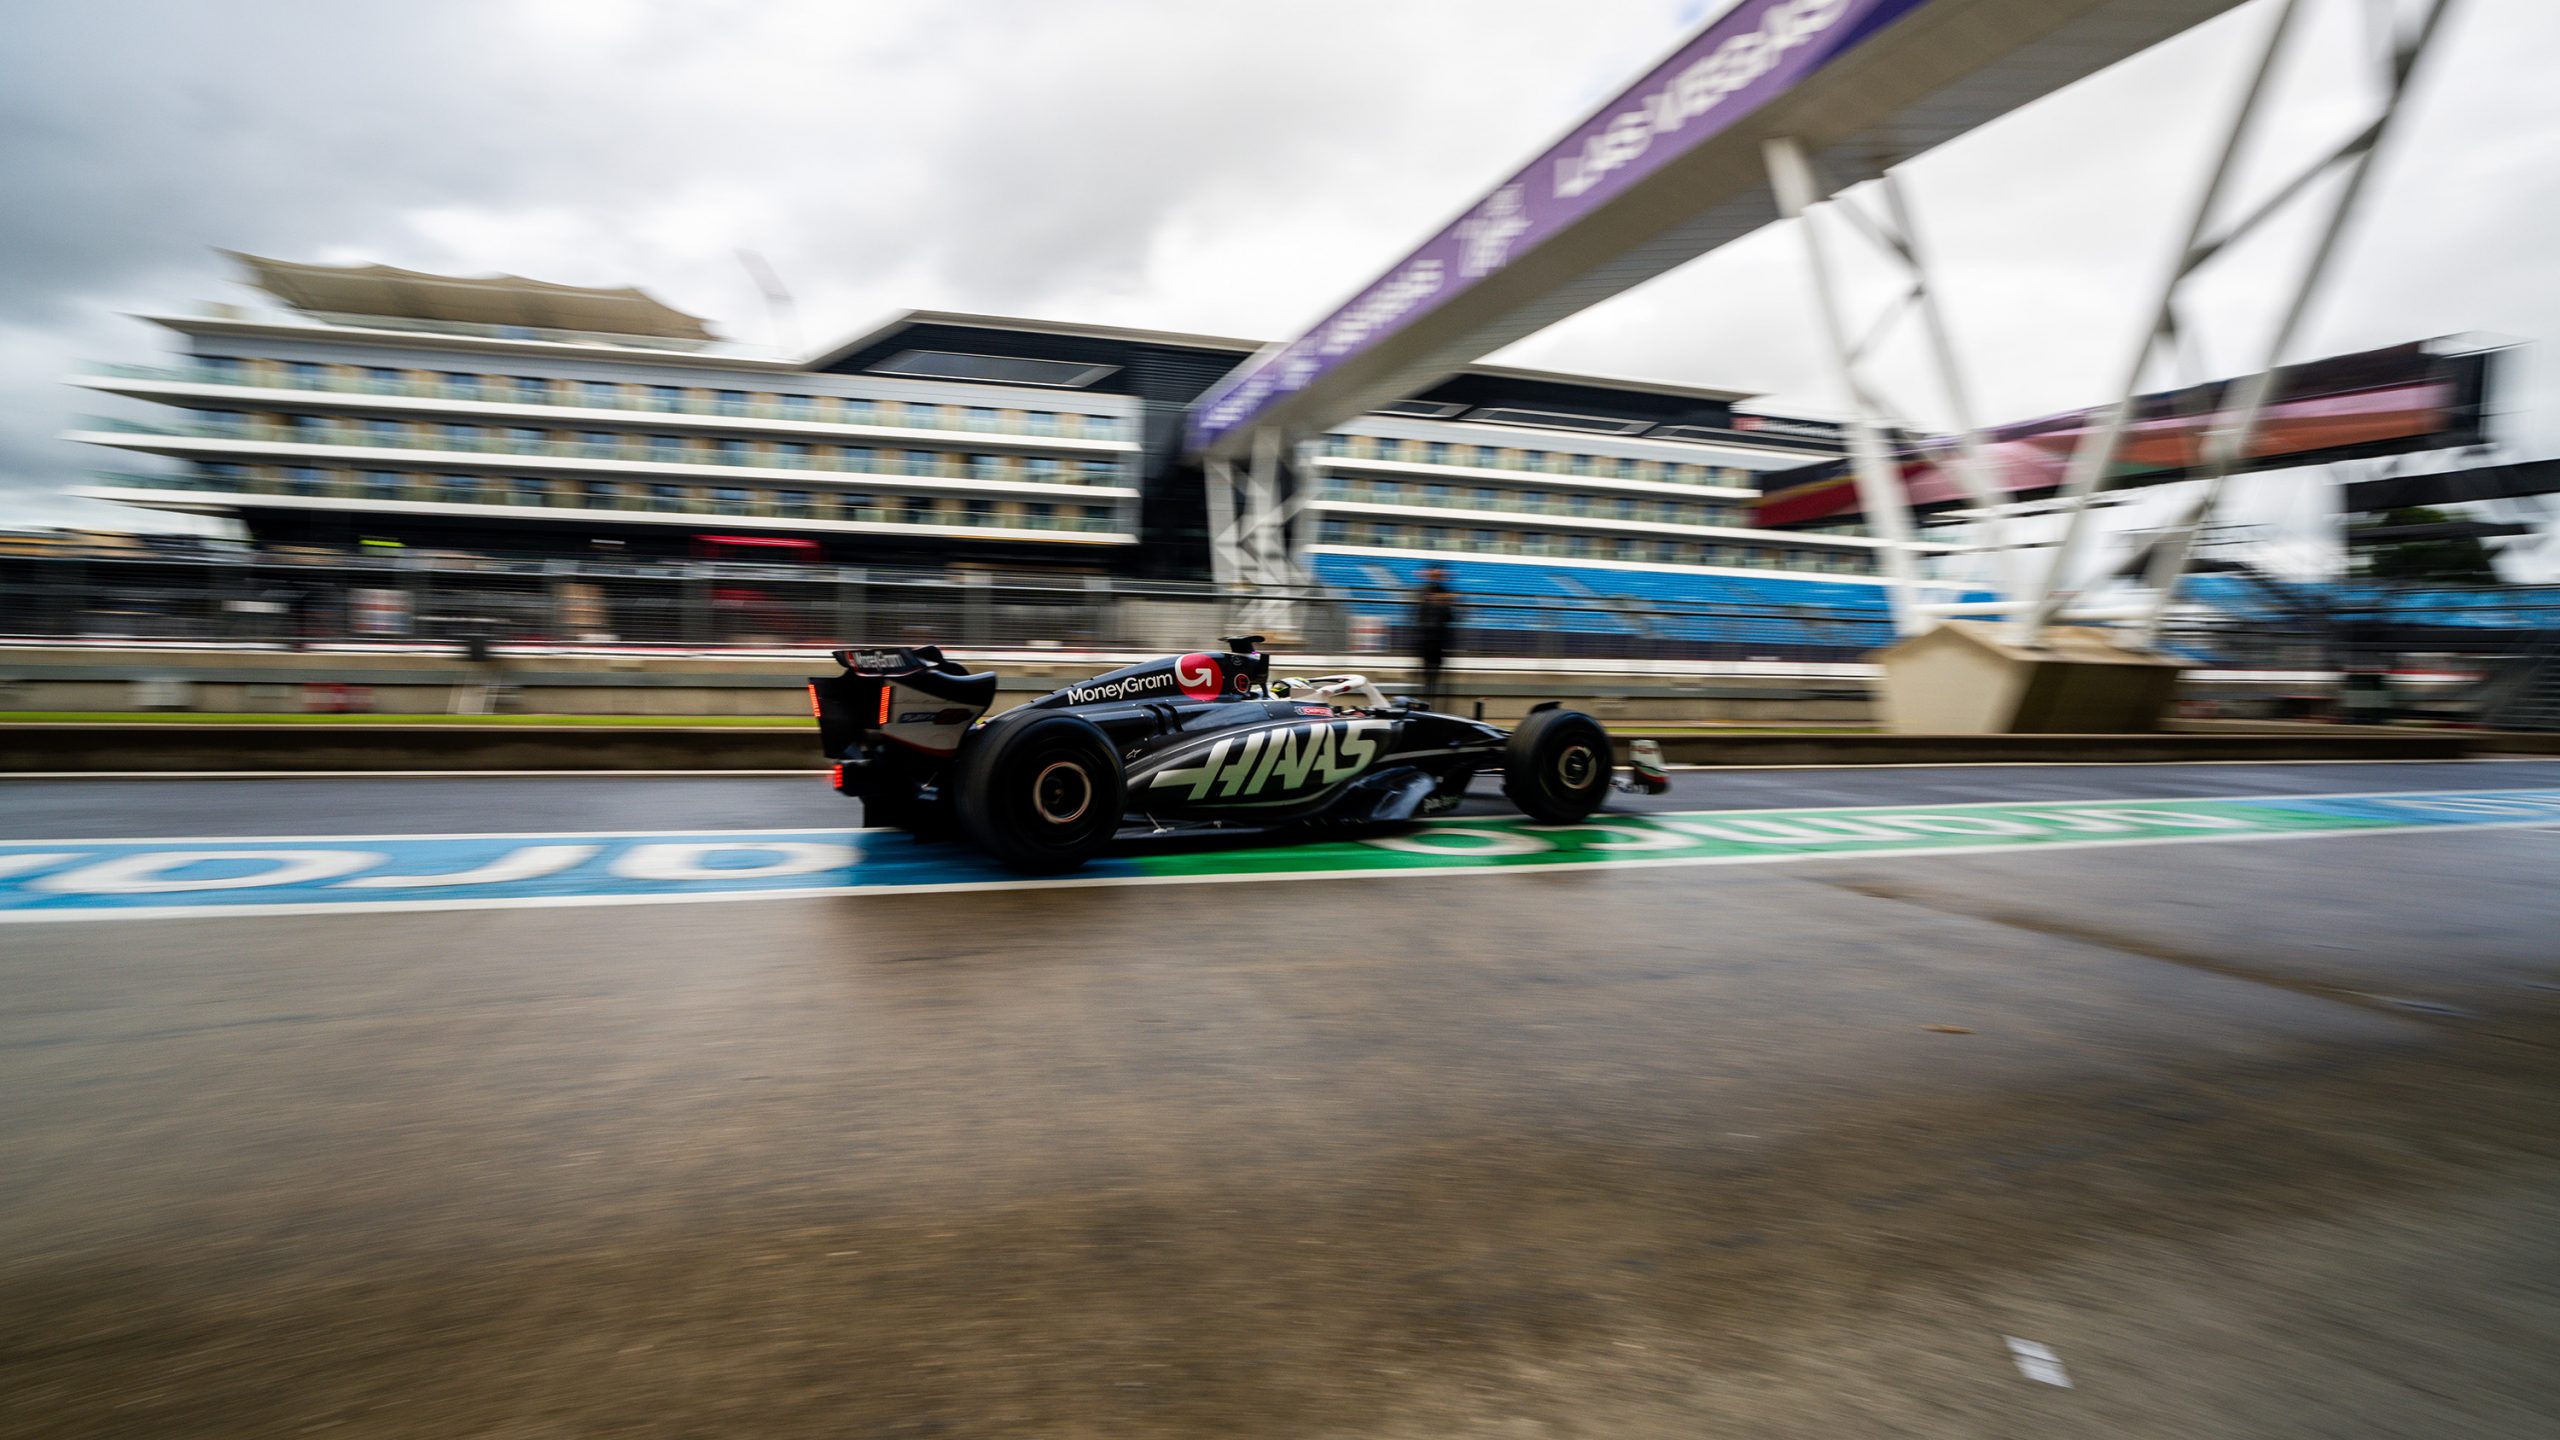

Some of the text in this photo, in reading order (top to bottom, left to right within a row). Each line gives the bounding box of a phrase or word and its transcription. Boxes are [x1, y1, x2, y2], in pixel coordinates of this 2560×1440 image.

[1553, 110, 1655, 198] LAS
[854, 651, 906, 671] MoneyGram
[1067, 673, 1174, 705] MoneyGram
[1150, 720, 1391, 801] HAAS
